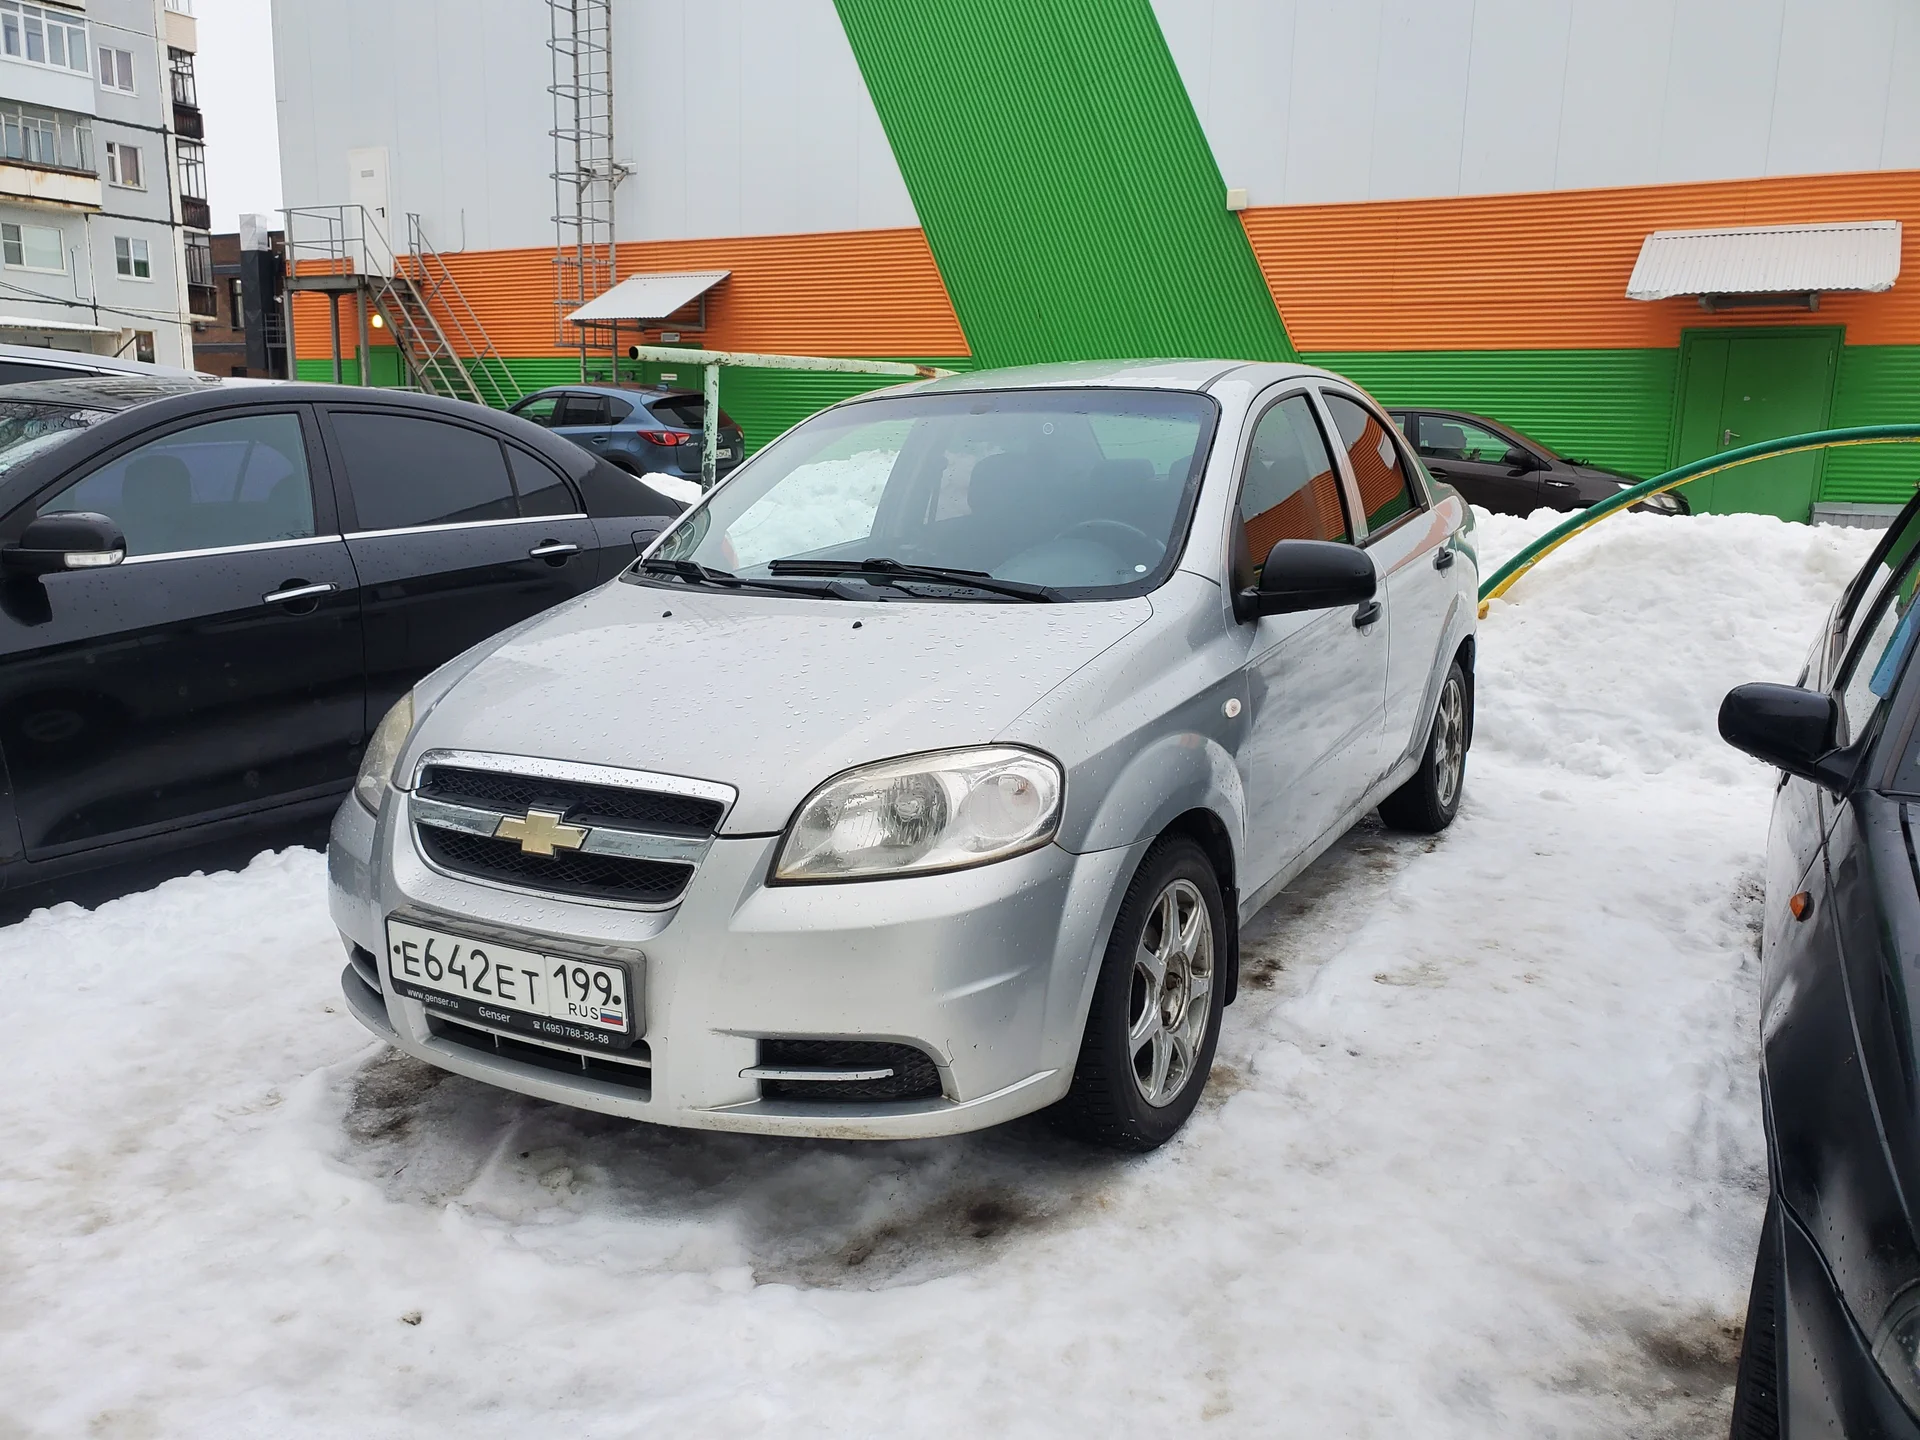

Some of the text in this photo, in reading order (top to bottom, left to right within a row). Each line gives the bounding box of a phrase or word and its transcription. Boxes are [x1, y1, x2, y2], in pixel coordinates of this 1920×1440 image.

[401, 938, 613, 1007] E642ET 199
[406, 988, 459, 1009] www.genser.ru
[478, 1006, 511, 1023] Genser
[568, 1002, 599, 1020] RUS
[542, 1021, 609, 1044] (495) 788-58-58
